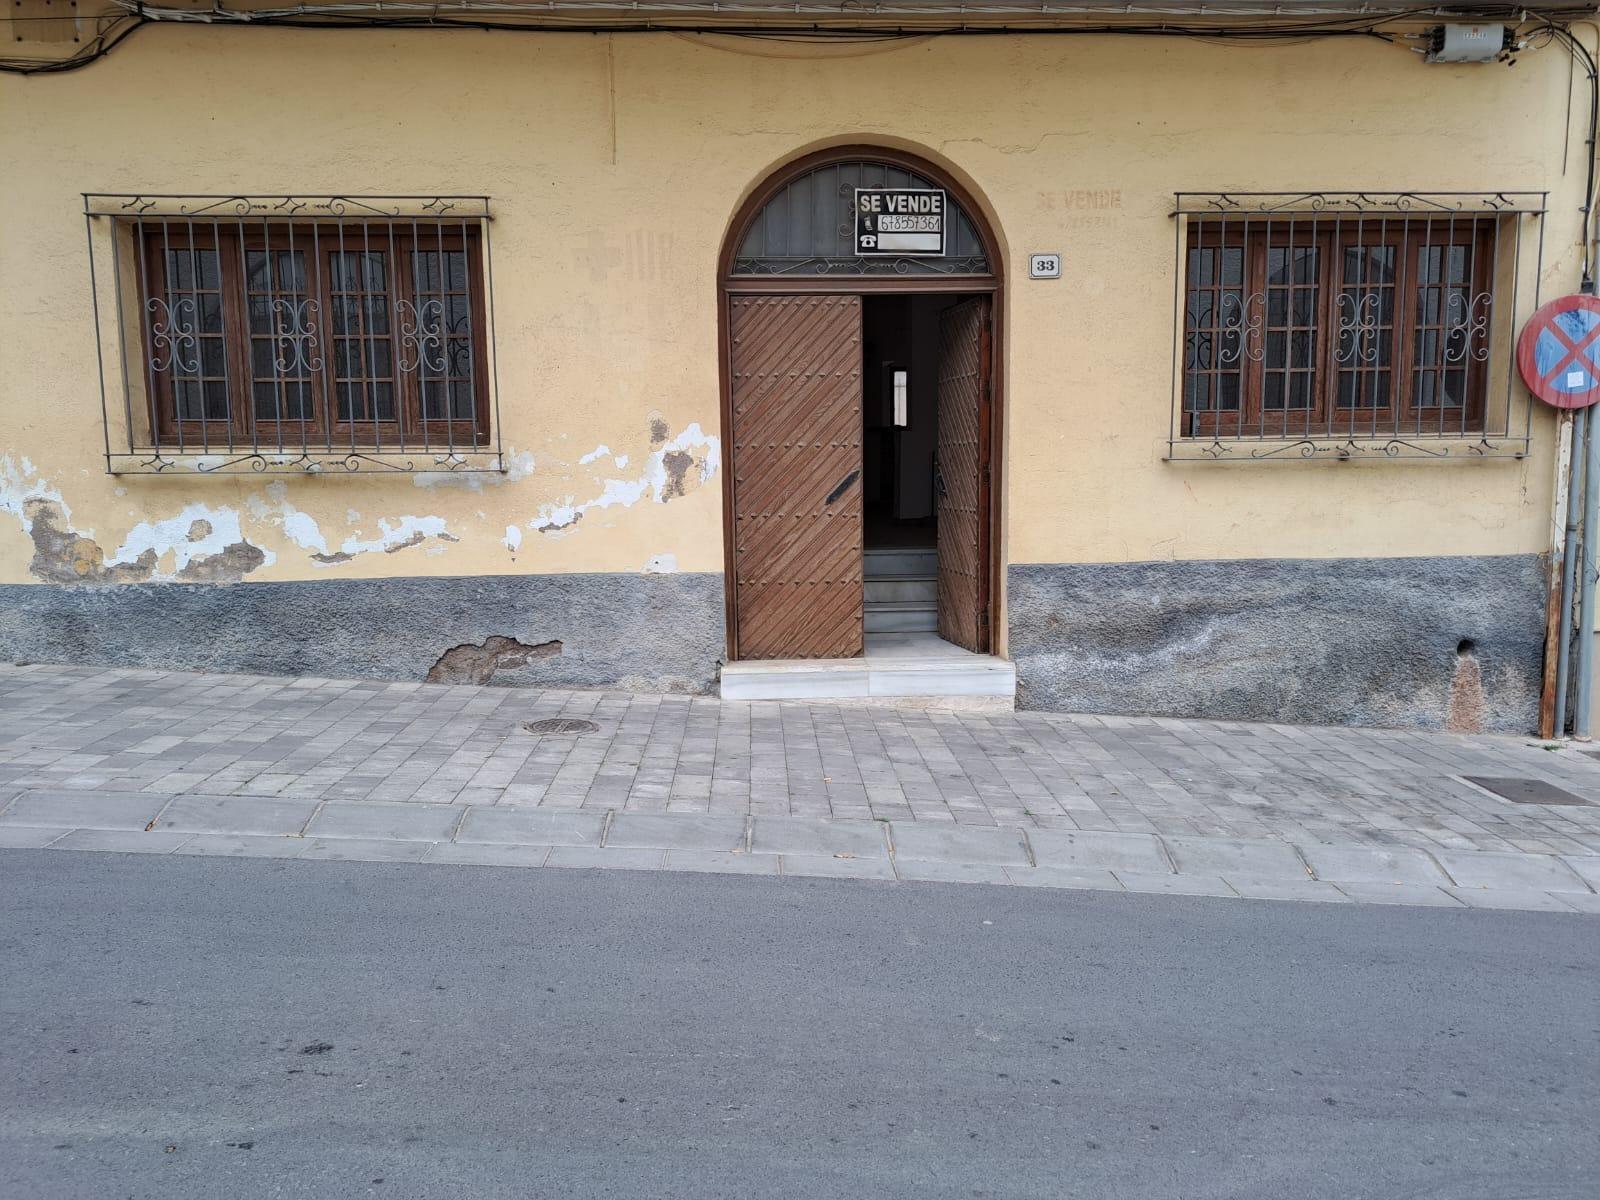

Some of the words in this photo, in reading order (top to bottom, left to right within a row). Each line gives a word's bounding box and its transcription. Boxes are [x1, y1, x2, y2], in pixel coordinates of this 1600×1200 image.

[860, 195, 881, 212] SE
[885, 195, 941, 213] VENDE
[1064, 189, 1122, 209] VENDE
[1037, 260, 1055, 271] 33
